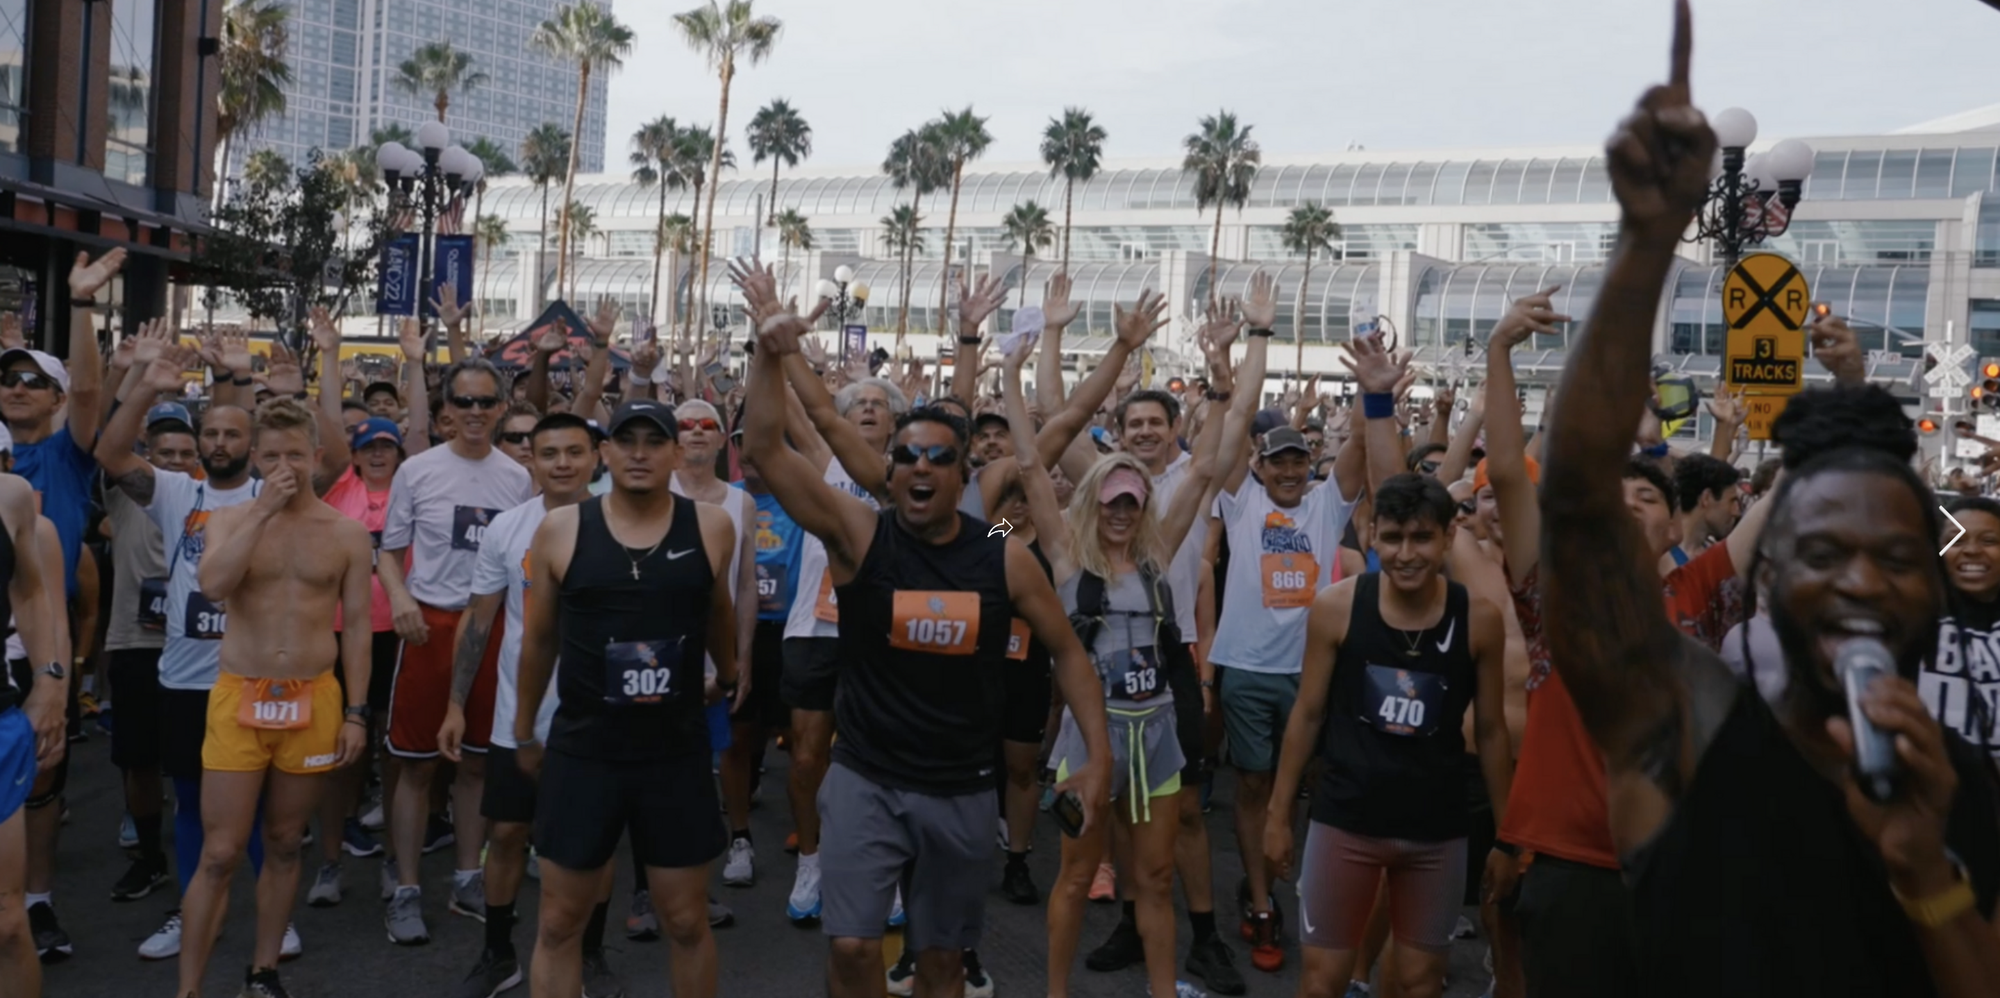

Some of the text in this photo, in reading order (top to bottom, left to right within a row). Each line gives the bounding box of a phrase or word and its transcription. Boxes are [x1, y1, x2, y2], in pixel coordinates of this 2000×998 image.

[1729, 288, 1803, 311] R R
[1759, 340, 1771, 358] 3
[1734, 364, 1795, 380] TRACKS
[1754, 403, 1771, 414] NO
[464, 524, 487, 544] 40
[755, 579, 777, 596] 57
[1272, 571, 1306, 589] 866
[906, 617, 967, 646] 1057
[623, 667, 671, 696] 302
[1124, 668, 1156, 694] 513
[252, 700, 299, 721] 1071
[1378, 695, 1425, 727] 470
